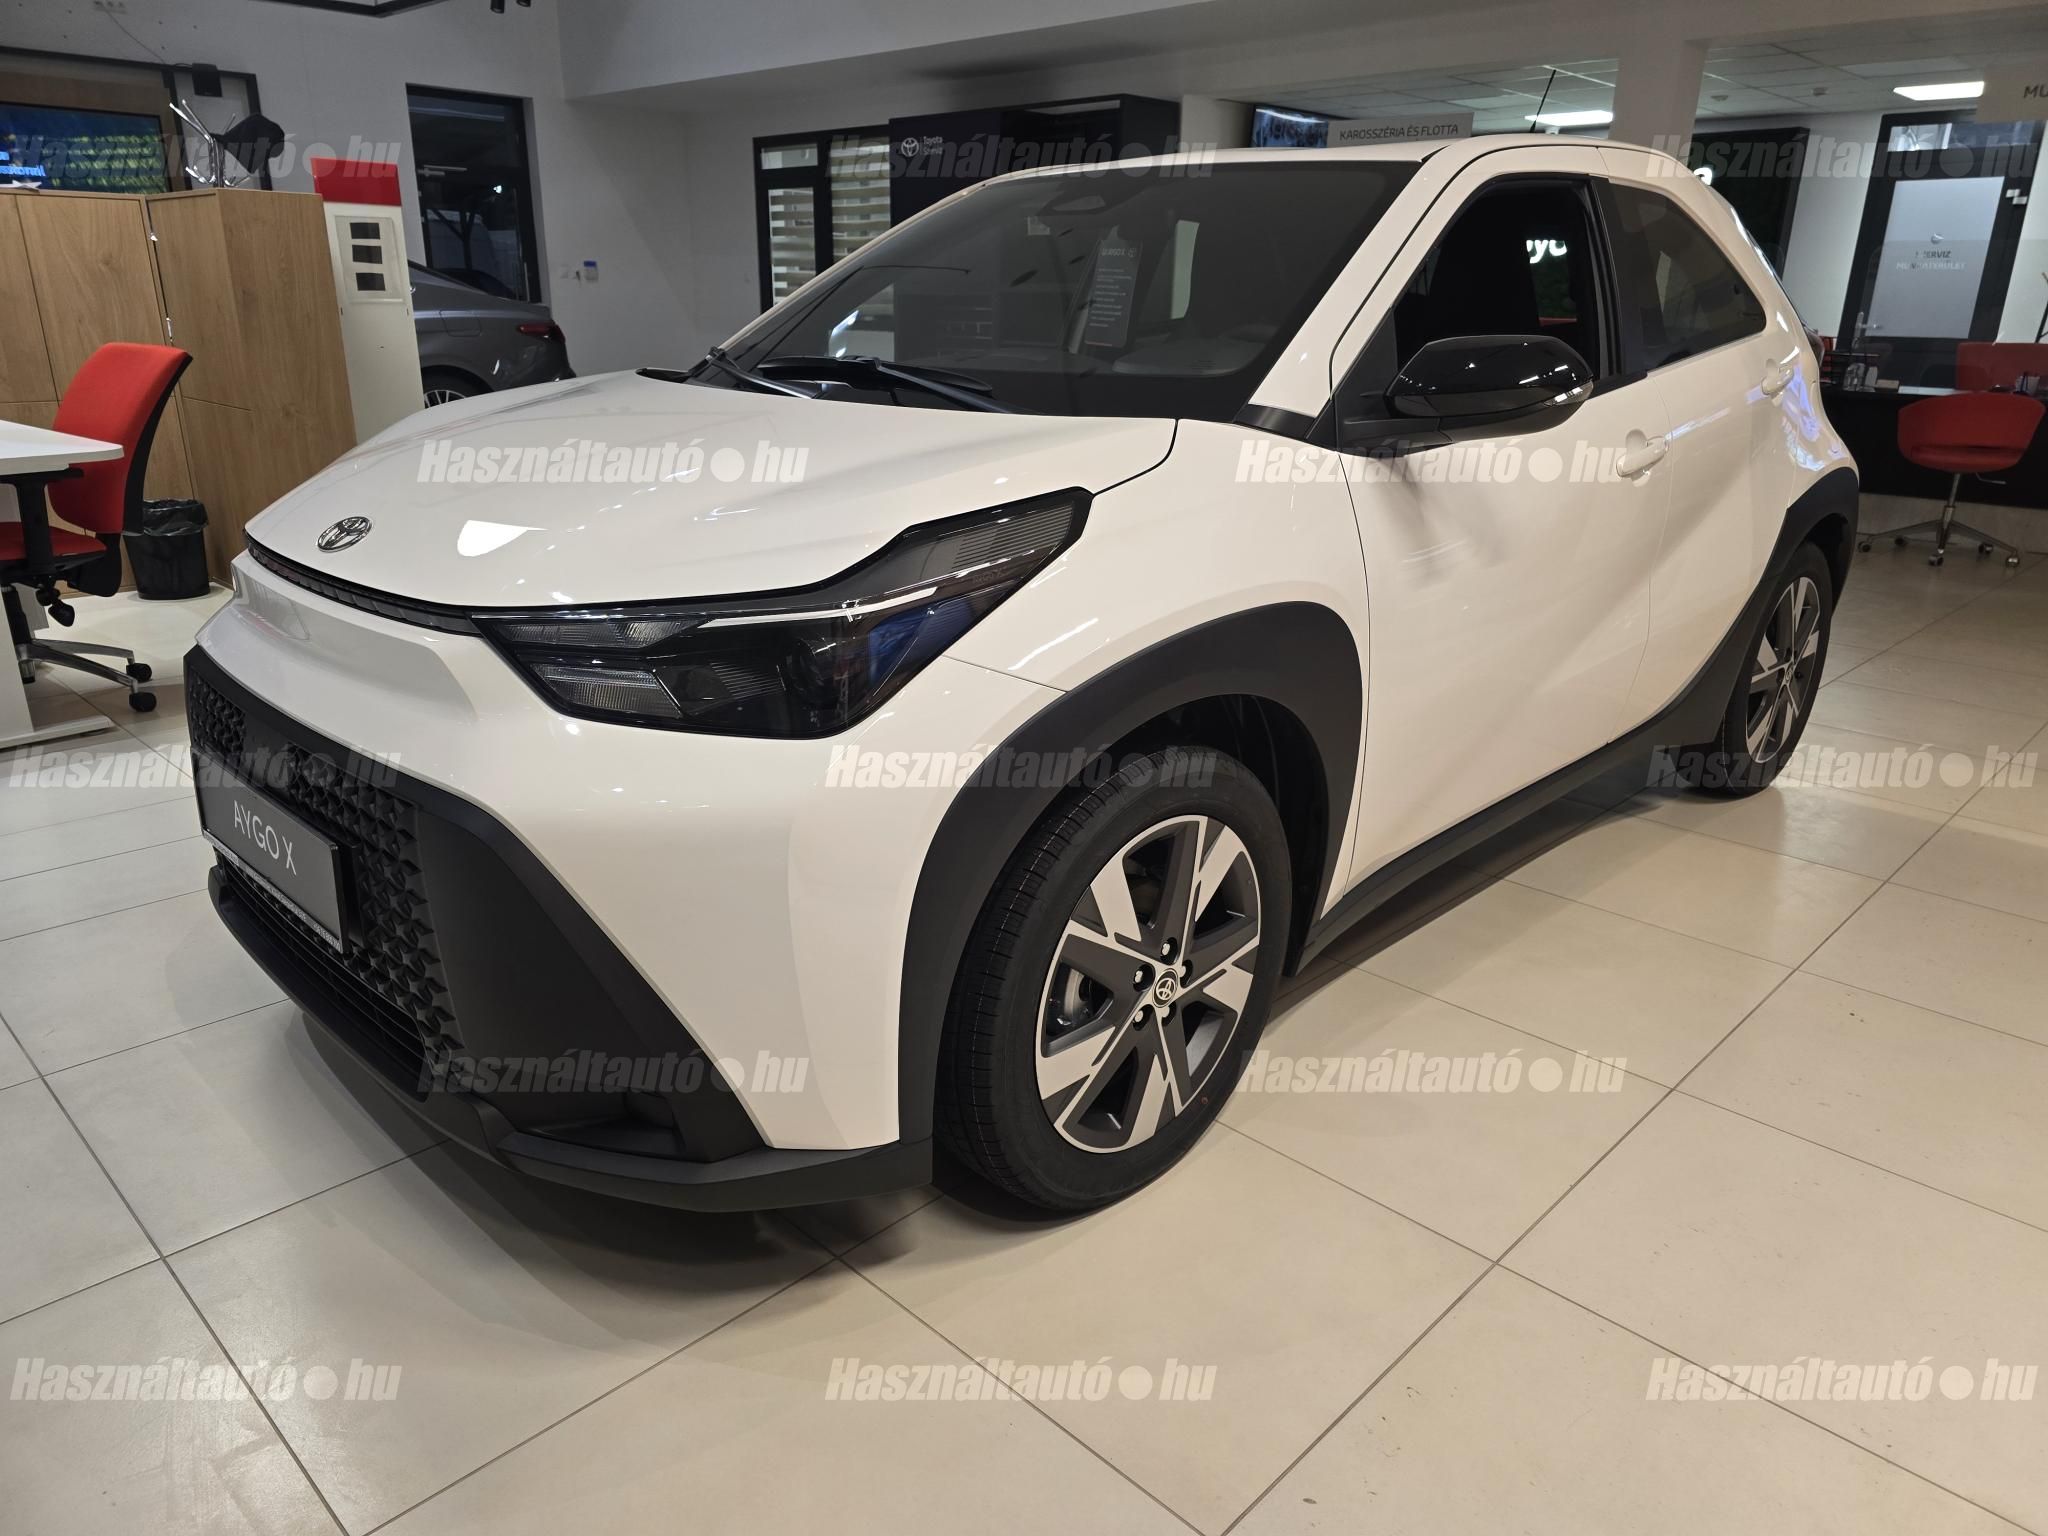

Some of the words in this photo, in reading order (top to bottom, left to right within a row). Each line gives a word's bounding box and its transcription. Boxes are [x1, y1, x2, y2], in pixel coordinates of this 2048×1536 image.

[1339, 125, 1404, 141] KAROSSZÉRIA
[1406, 124, 1419, 137] ÉS
[1420, 124, 1458, 137] FLOTTA
[234, 799, 280, 860] AYGO
[282, 836, 297, 876] X
